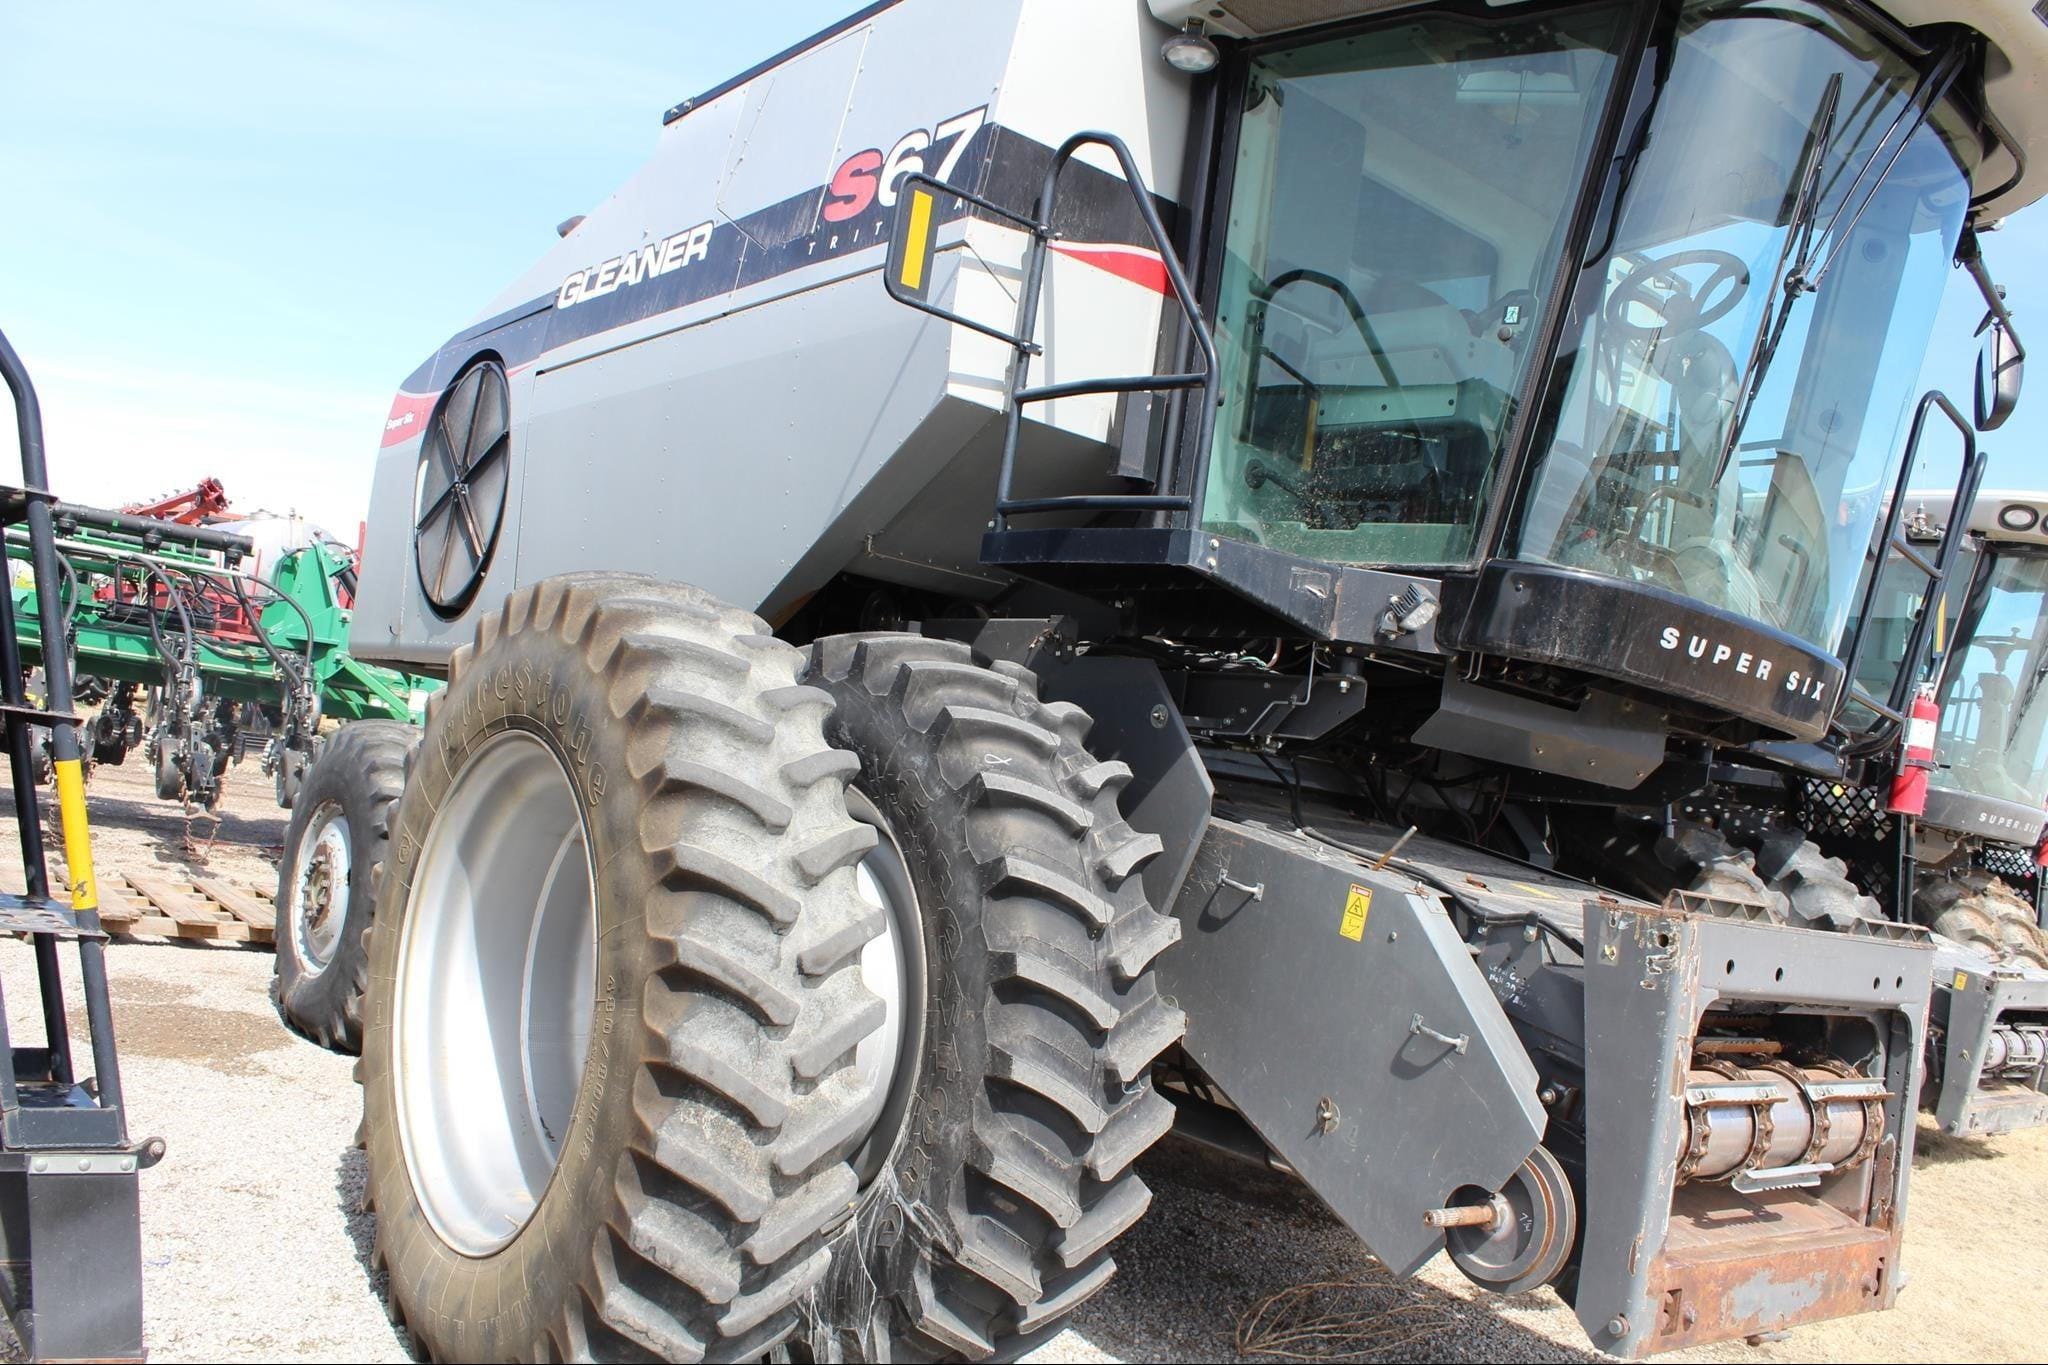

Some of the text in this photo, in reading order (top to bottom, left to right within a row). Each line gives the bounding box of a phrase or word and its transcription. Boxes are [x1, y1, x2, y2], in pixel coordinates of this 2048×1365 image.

[823, 103, 989, 223] S67
[556, 219, 715, 310] GLEANER
[1659, 627, 1825, 700] SUPER SIX
[1979, 812, 2039, 834] SUPER SIX
